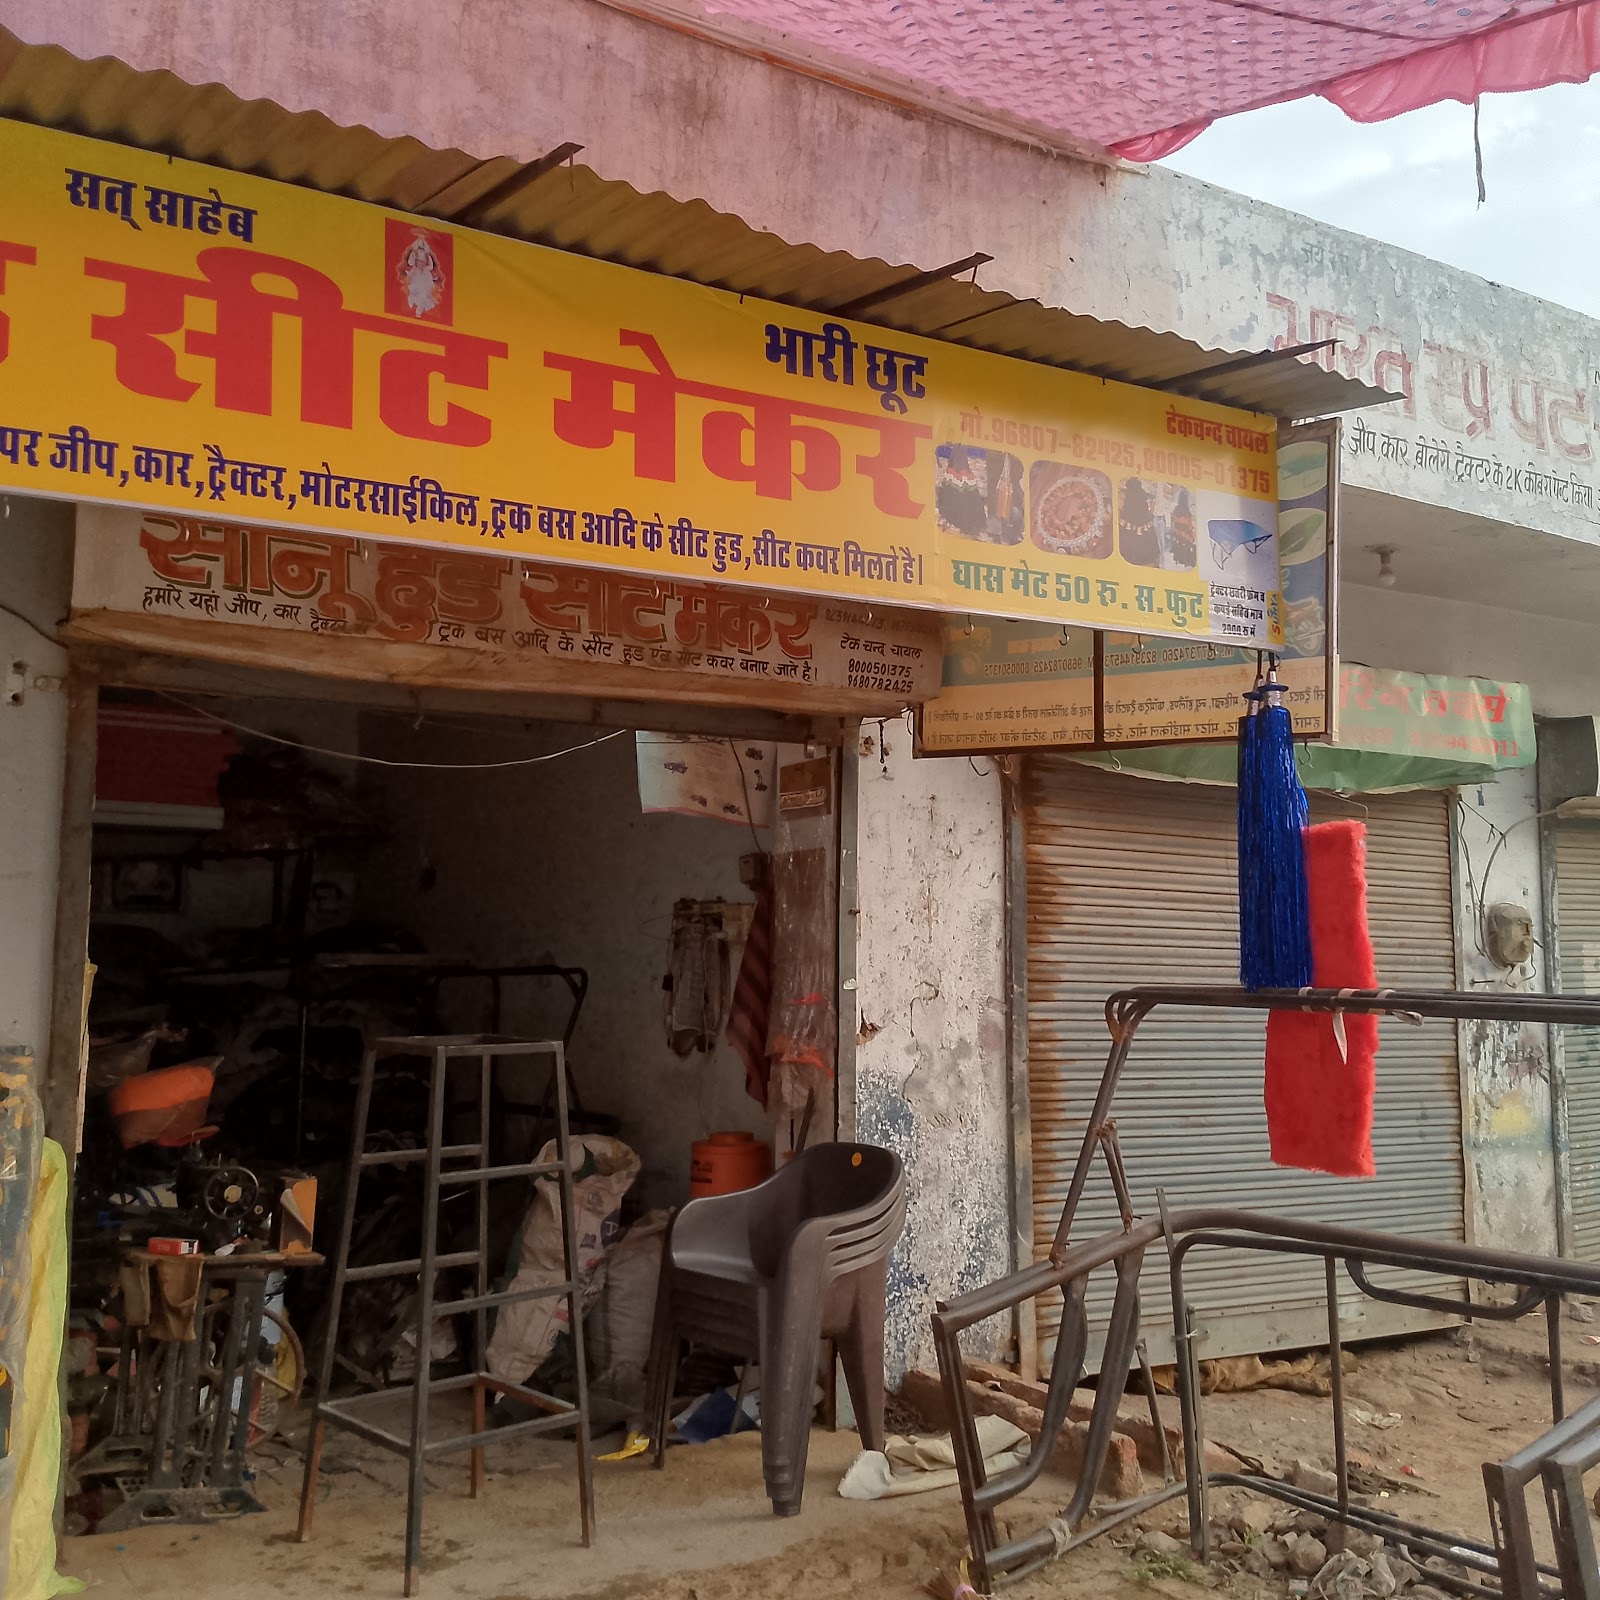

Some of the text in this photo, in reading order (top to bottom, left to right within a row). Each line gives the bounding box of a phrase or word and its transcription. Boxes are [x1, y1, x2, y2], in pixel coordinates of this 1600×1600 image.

[65, 168, 258, 243] सत् साहेब
[84, 246, 509, 448] सीट
[543, 328, 933, 520] मेकर
[764, 323, 928, 414] भारी छूट
[1505, 465, 1523, 494] 2K
[537, 506, 576, 540] बस
[581, 508, 638, 551] आदि
[642, 512, 664, 552] के
[668, 518, 709, 557] सीट
[752, 529, 792, 568] सीट
[796, 542, 840, 576] कवर
[951, 558, 1006, 595] घास
[1010, 558, 1049, 599] मेट
[1055, 573, 1090, 604] 50
[142, 586, 186, 616] हमारे
[272, 602, 303, 625] कार
[475, 625, 505, 645] बस
[512, 628, 551, 654] आदि
[557, 631, 575, 652] के
[582, 634, 614, 657] सीट
[676, 646, 702, 666] सीट
[706, 654, 735, 671] कवर
[740, 657, 771, 676] बनाए
[773, 659, 800, 677] जाते
[840, 633, 922, 661] टेक चन्द चायल
[847, 673, 915, 694] 9680782425
[848, 657, 912, 678] 8000501375
